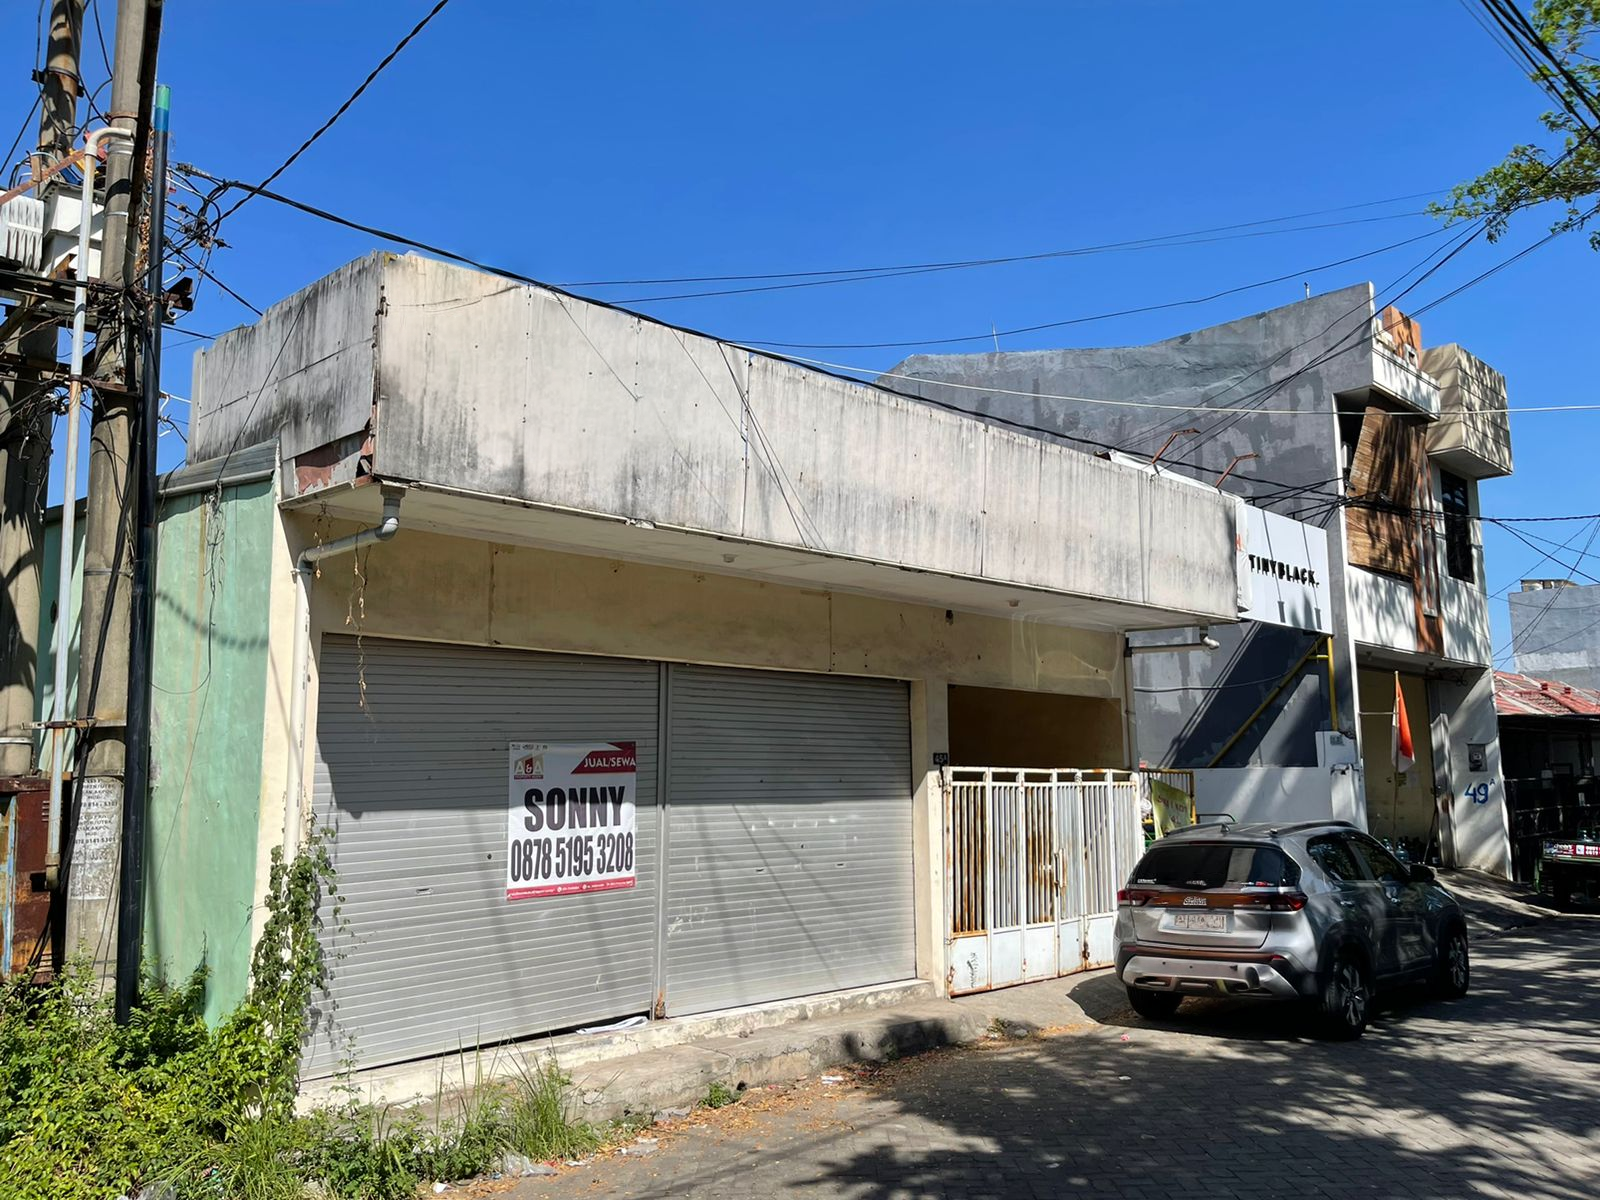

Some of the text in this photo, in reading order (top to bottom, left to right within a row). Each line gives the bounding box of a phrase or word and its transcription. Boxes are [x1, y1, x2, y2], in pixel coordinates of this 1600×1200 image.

[515, 760, 544, 775] A&A
[584, 757, 636, 768] JUAL/SEWA
[524, 785, 626, 833] SONNY
[511, 831, 633, 882] 0878 5195 3208
